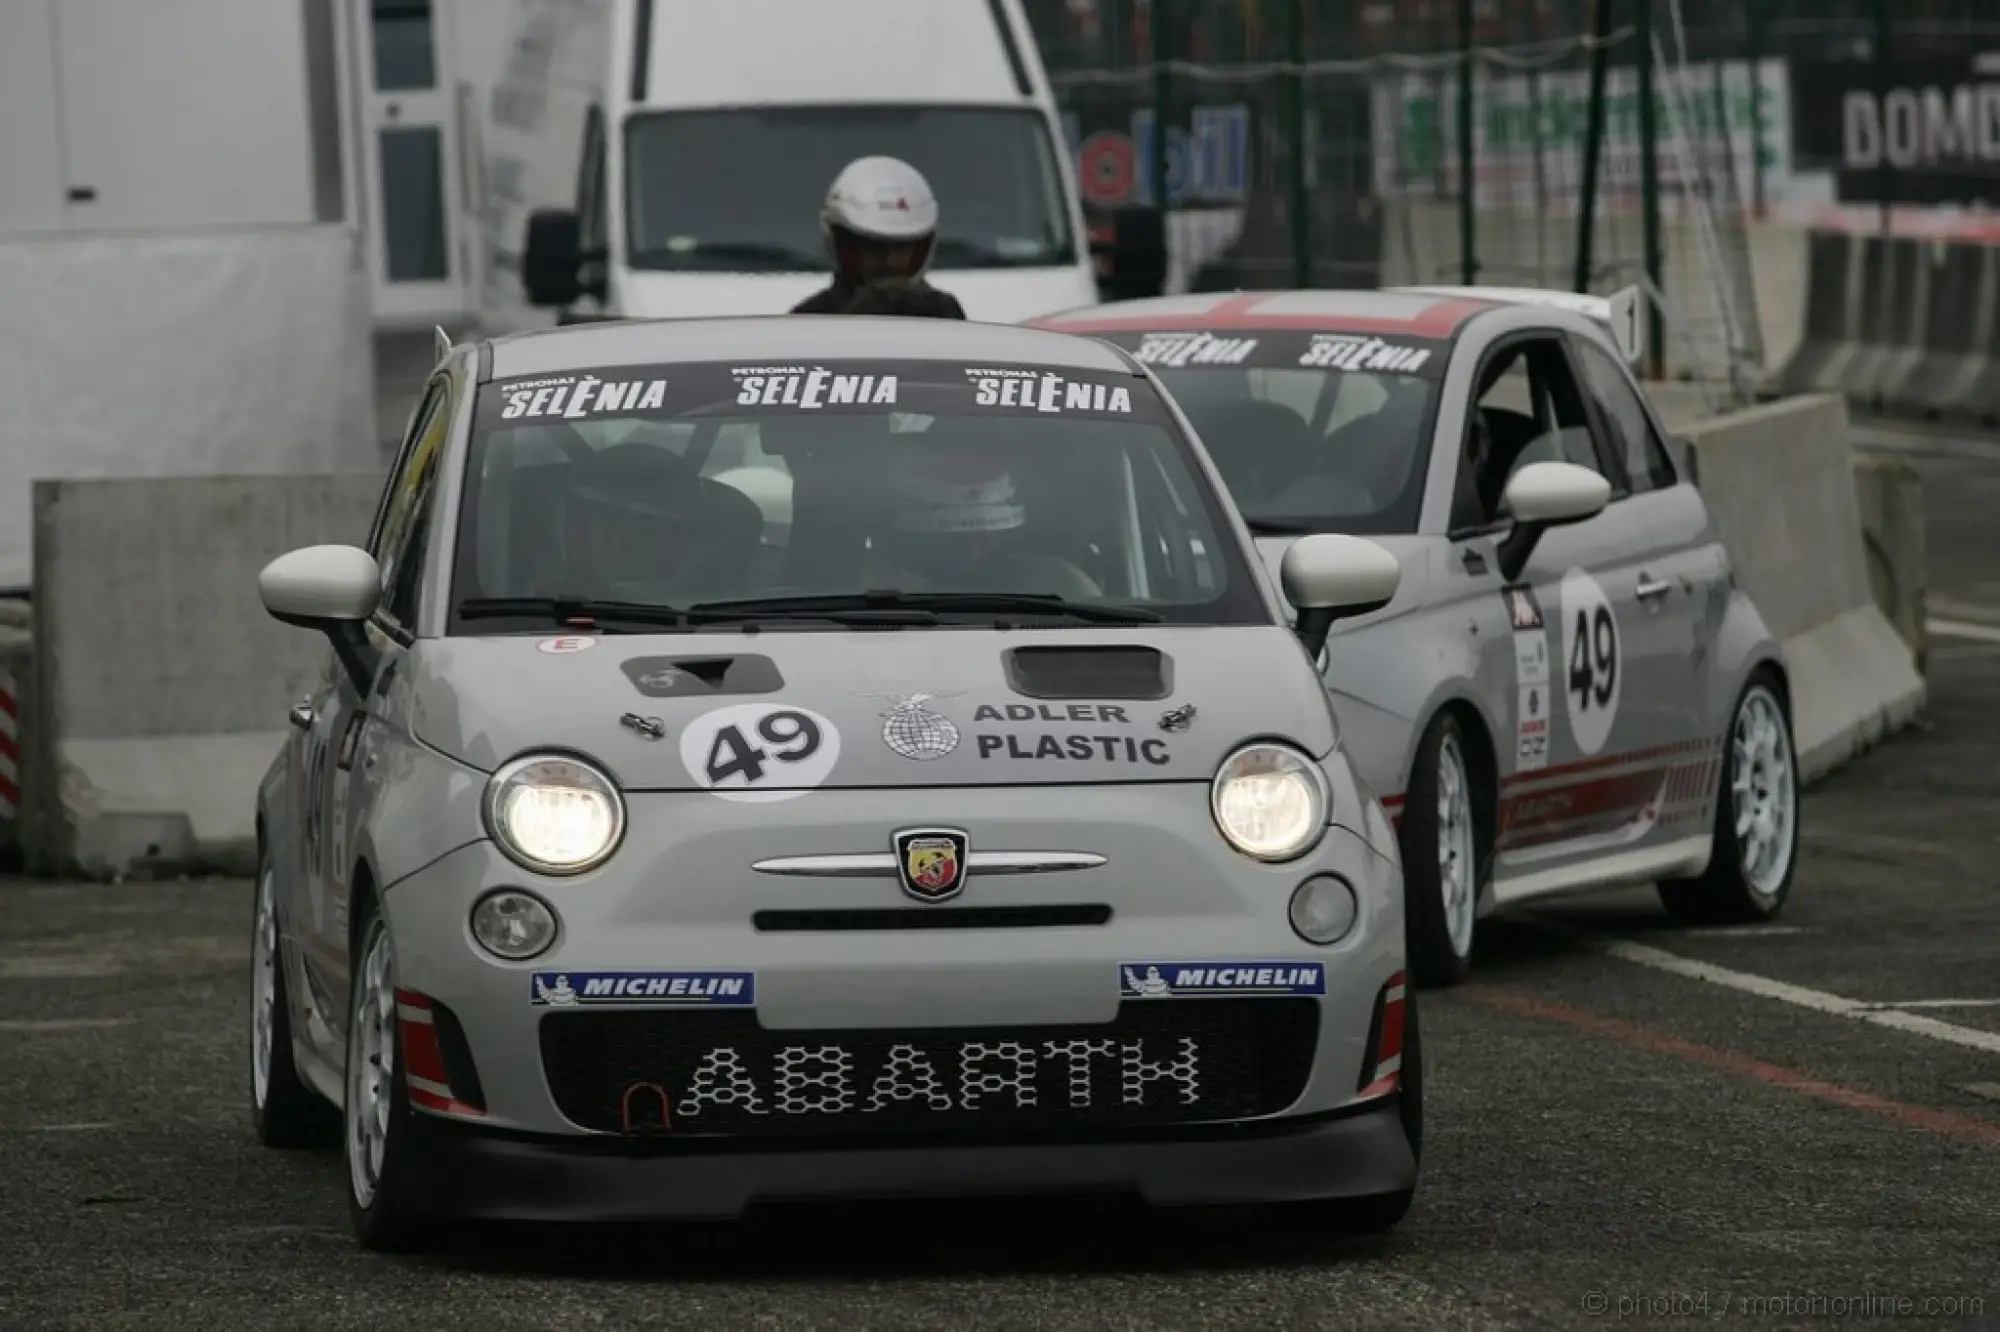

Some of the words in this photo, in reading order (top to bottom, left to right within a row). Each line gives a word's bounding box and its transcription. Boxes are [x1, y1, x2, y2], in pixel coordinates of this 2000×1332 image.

[1570, 606, 1616, 712] 49
[974, 704, 1131, 723] ADLER
[705, 709, 823, 785] 49
[976, 734, 1171, 766] PLASTIC
[583, 977, 745, 996] MICHELIN
[1175, 968, 1319, 986] MICHELIN
[677, 1038, 1198, 1114] ABARTH
